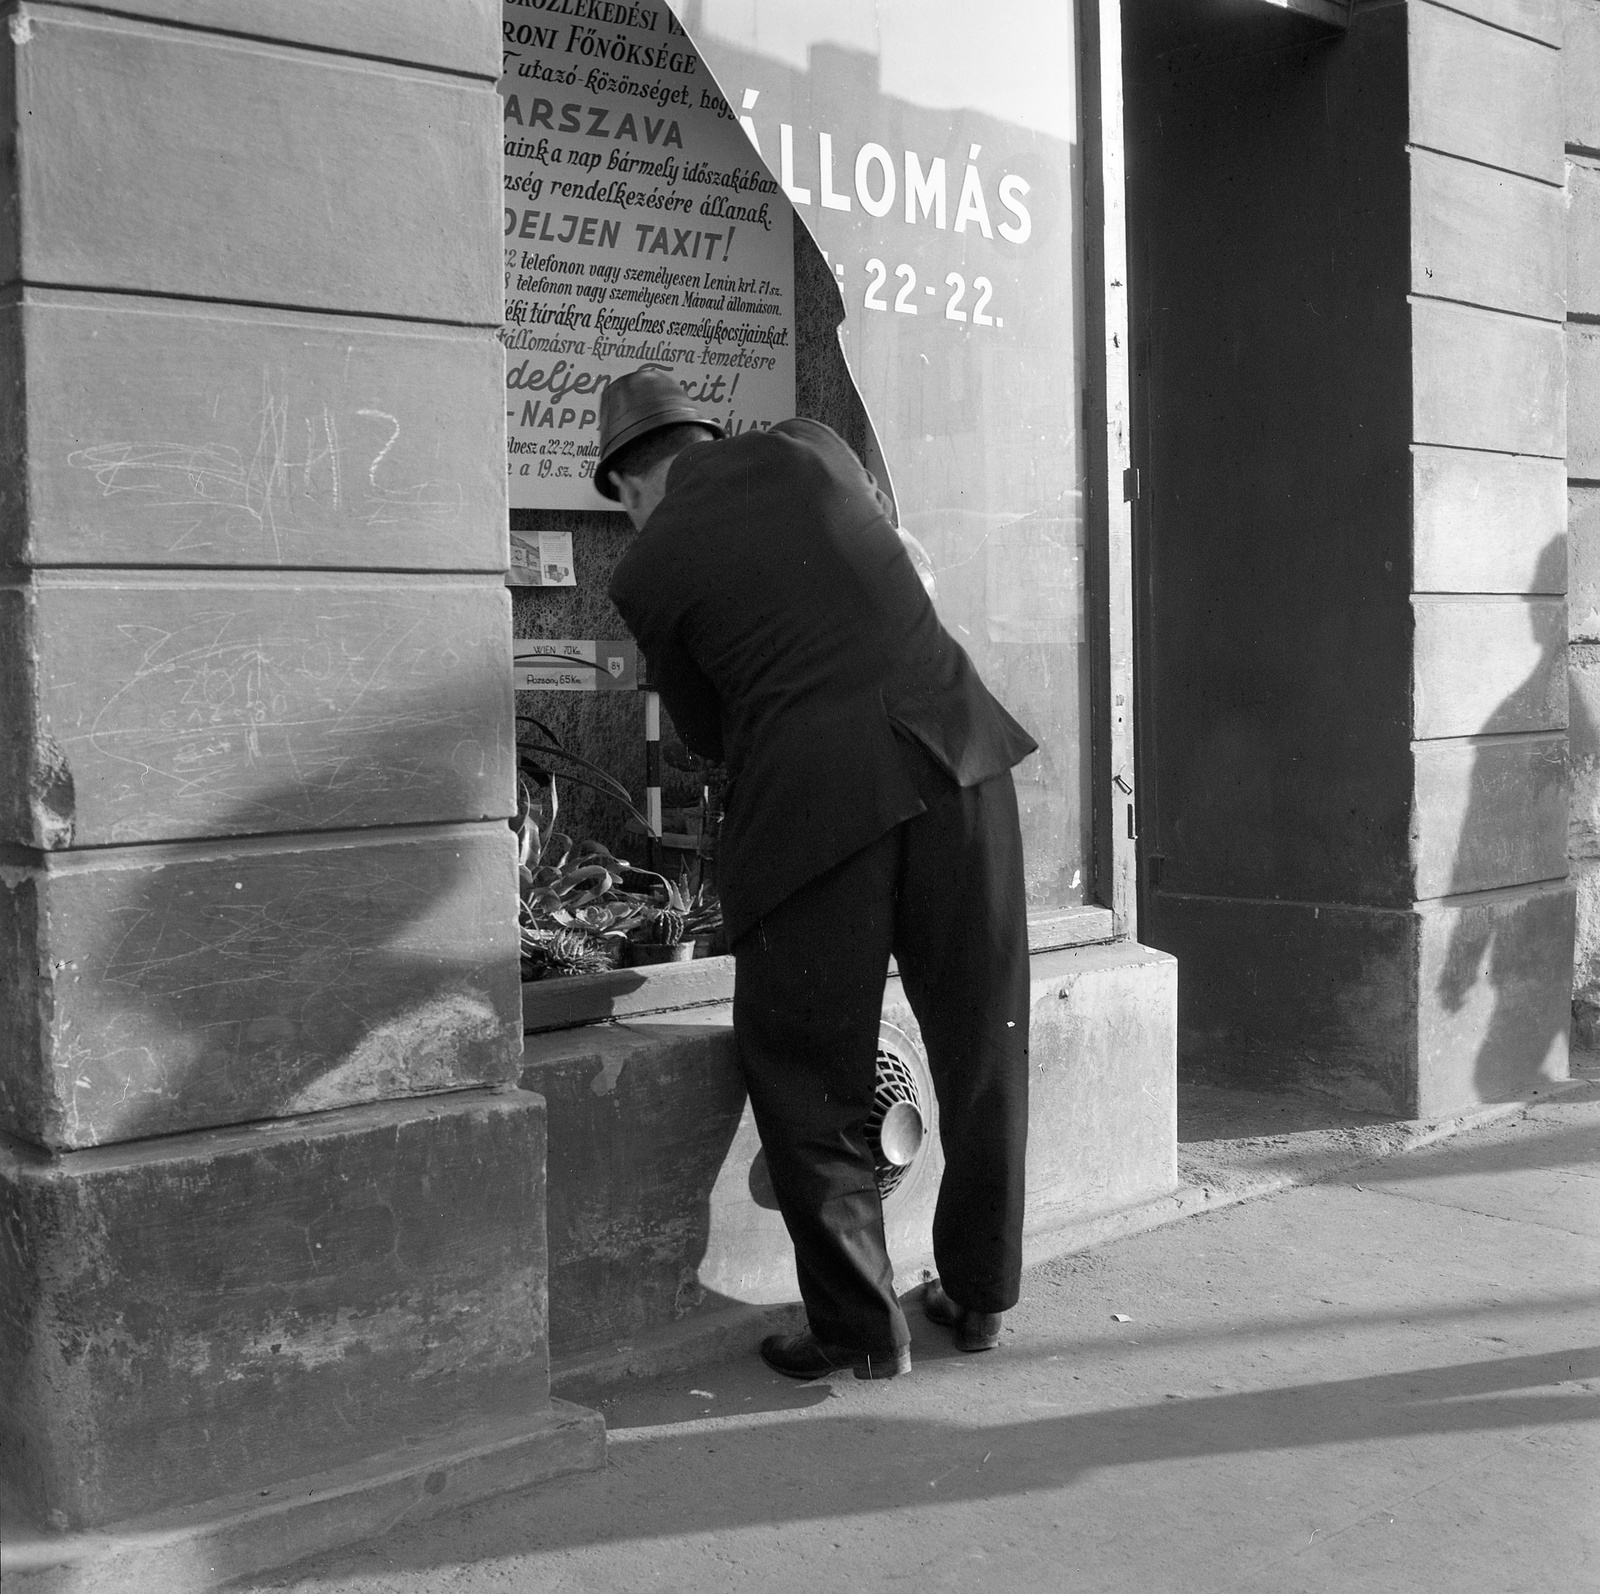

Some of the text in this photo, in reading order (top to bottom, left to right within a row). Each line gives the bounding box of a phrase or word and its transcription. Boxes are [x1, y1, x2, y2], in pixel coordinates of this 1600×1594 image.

[564, 24, 697, 75] FŐNÖKSÉGE
[518, 59, 693, 109] utazó-közönséget,
[504, 93, 683, 149] ARSZAVA
[550, 147, 563, 163] a
[566, 150, 602, 174] nap
[606, 148, 679, 186] bármely
[682, 161, 778, 194] időszakában
[550, 180, 693, 213] rendelkezésére
[700, 195, 772, 231] állanak.
[636, 224, 736, 262] TAXIT!
[517, 274, 573, 296] telefonon
[576, 284, 607, 304] vagy
[609, 286, 679, 309] személyesen
[681, 290, 725, 311] Mávaut
[726, 297, 782, 316] állomáson.
[520, 250, 585, 276] telefonon
[589, 263, 621, 284] vagy
[624, 266, 701, 290] személyesen
[703, 272, 737, 292] Lenin
[738, 277, 757, 294] krt.
[863, 258, 1004, 328] 22-22.
[529, 302, 592, 331] túrákra
[594, 307, 666, 337] kényelmes
[667, 317, 789, 350] személykocsijainkat.
[519, 462, 531, 477] a
[533, 645, 556, 655] WIEN
